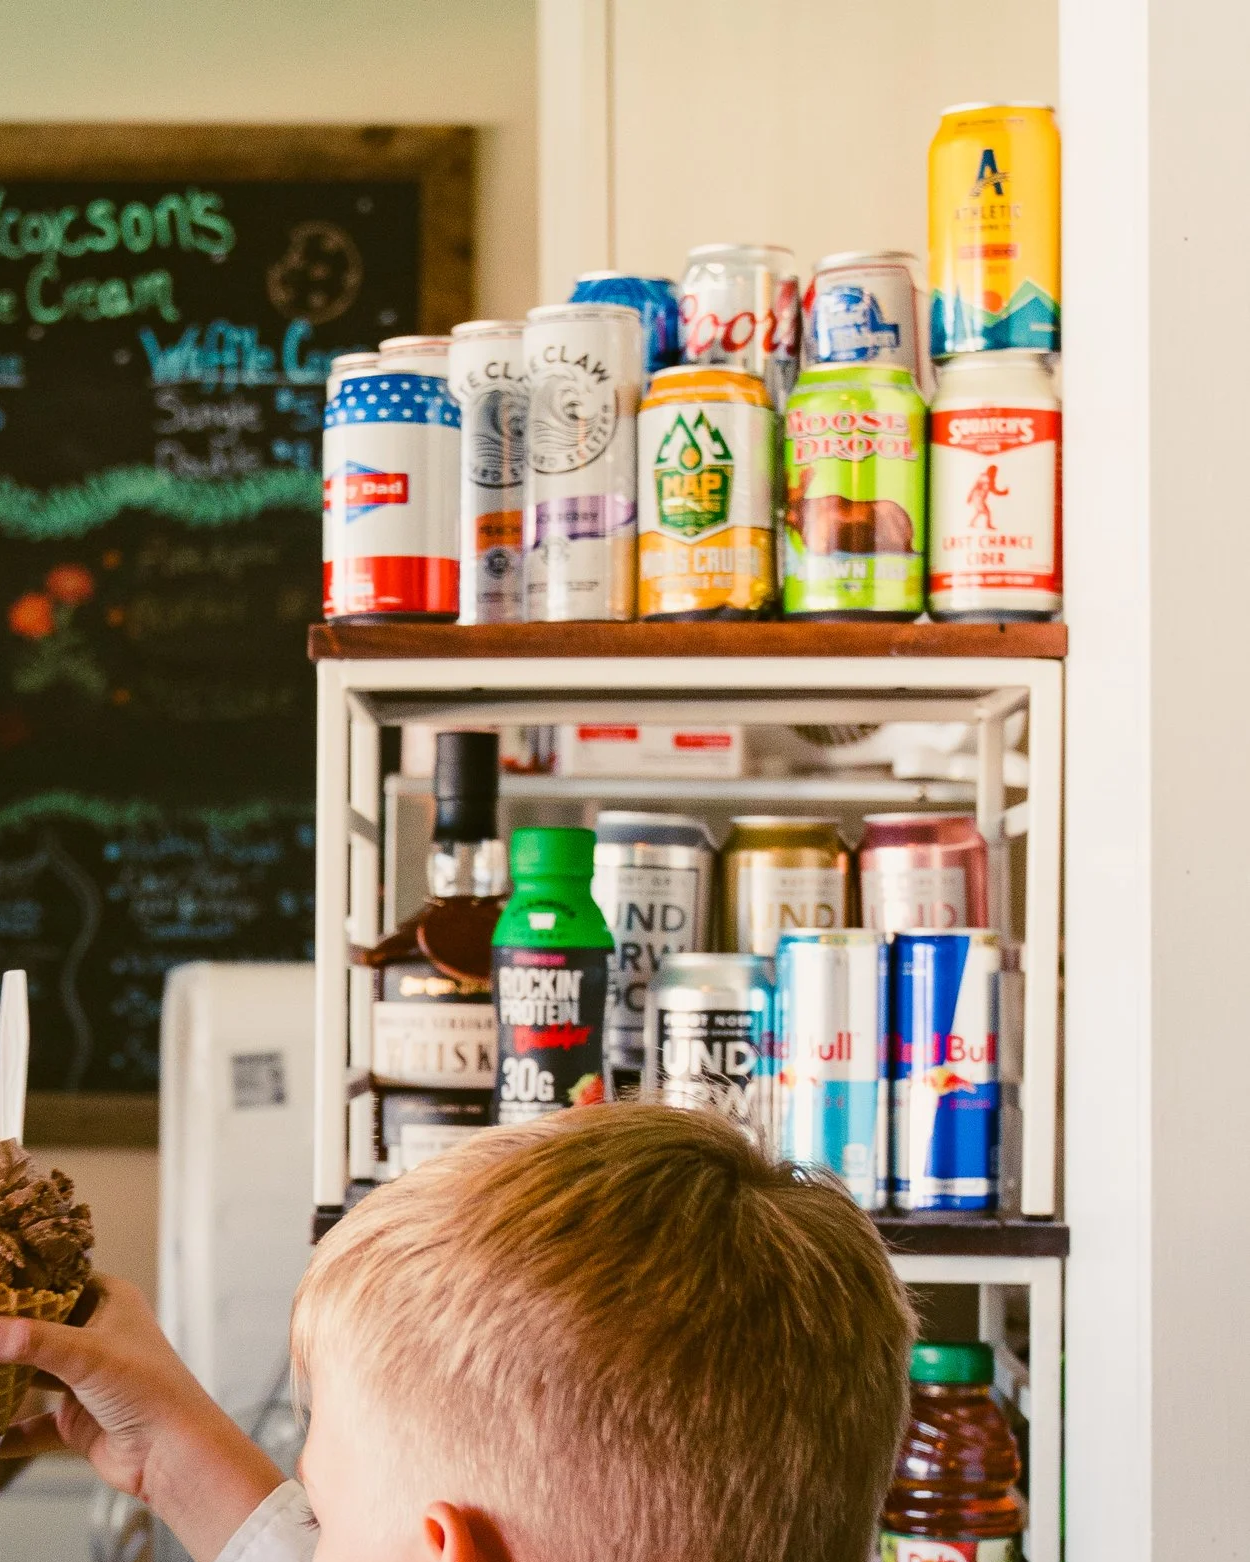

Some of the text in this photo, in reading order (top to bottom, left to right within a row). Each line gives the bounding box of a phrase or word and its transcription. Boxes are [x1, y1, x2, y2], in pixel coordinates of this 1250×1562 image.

[543, 346, 611, 385] CLAW
[795, 434, 920, 466] DROOL
[361, 480, 403, 496] Dad
[662, 1039, 757, 1077] UND
